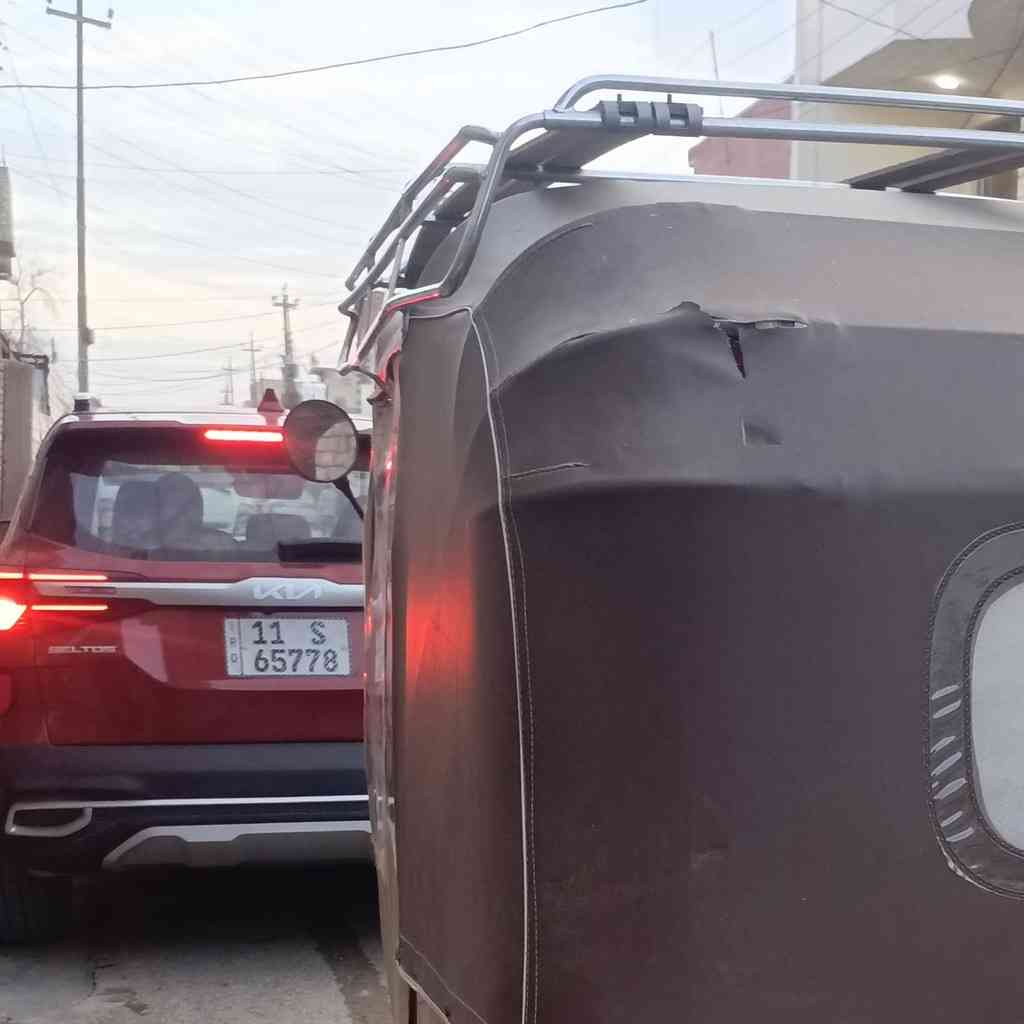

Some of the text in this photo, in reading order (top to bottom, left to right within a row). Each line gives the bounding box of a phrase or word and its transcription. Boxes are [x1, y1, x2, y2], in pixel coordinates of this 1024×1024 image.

[252, 620, 327, 645] 11 S
[254, 648, 339, 673] 65778
